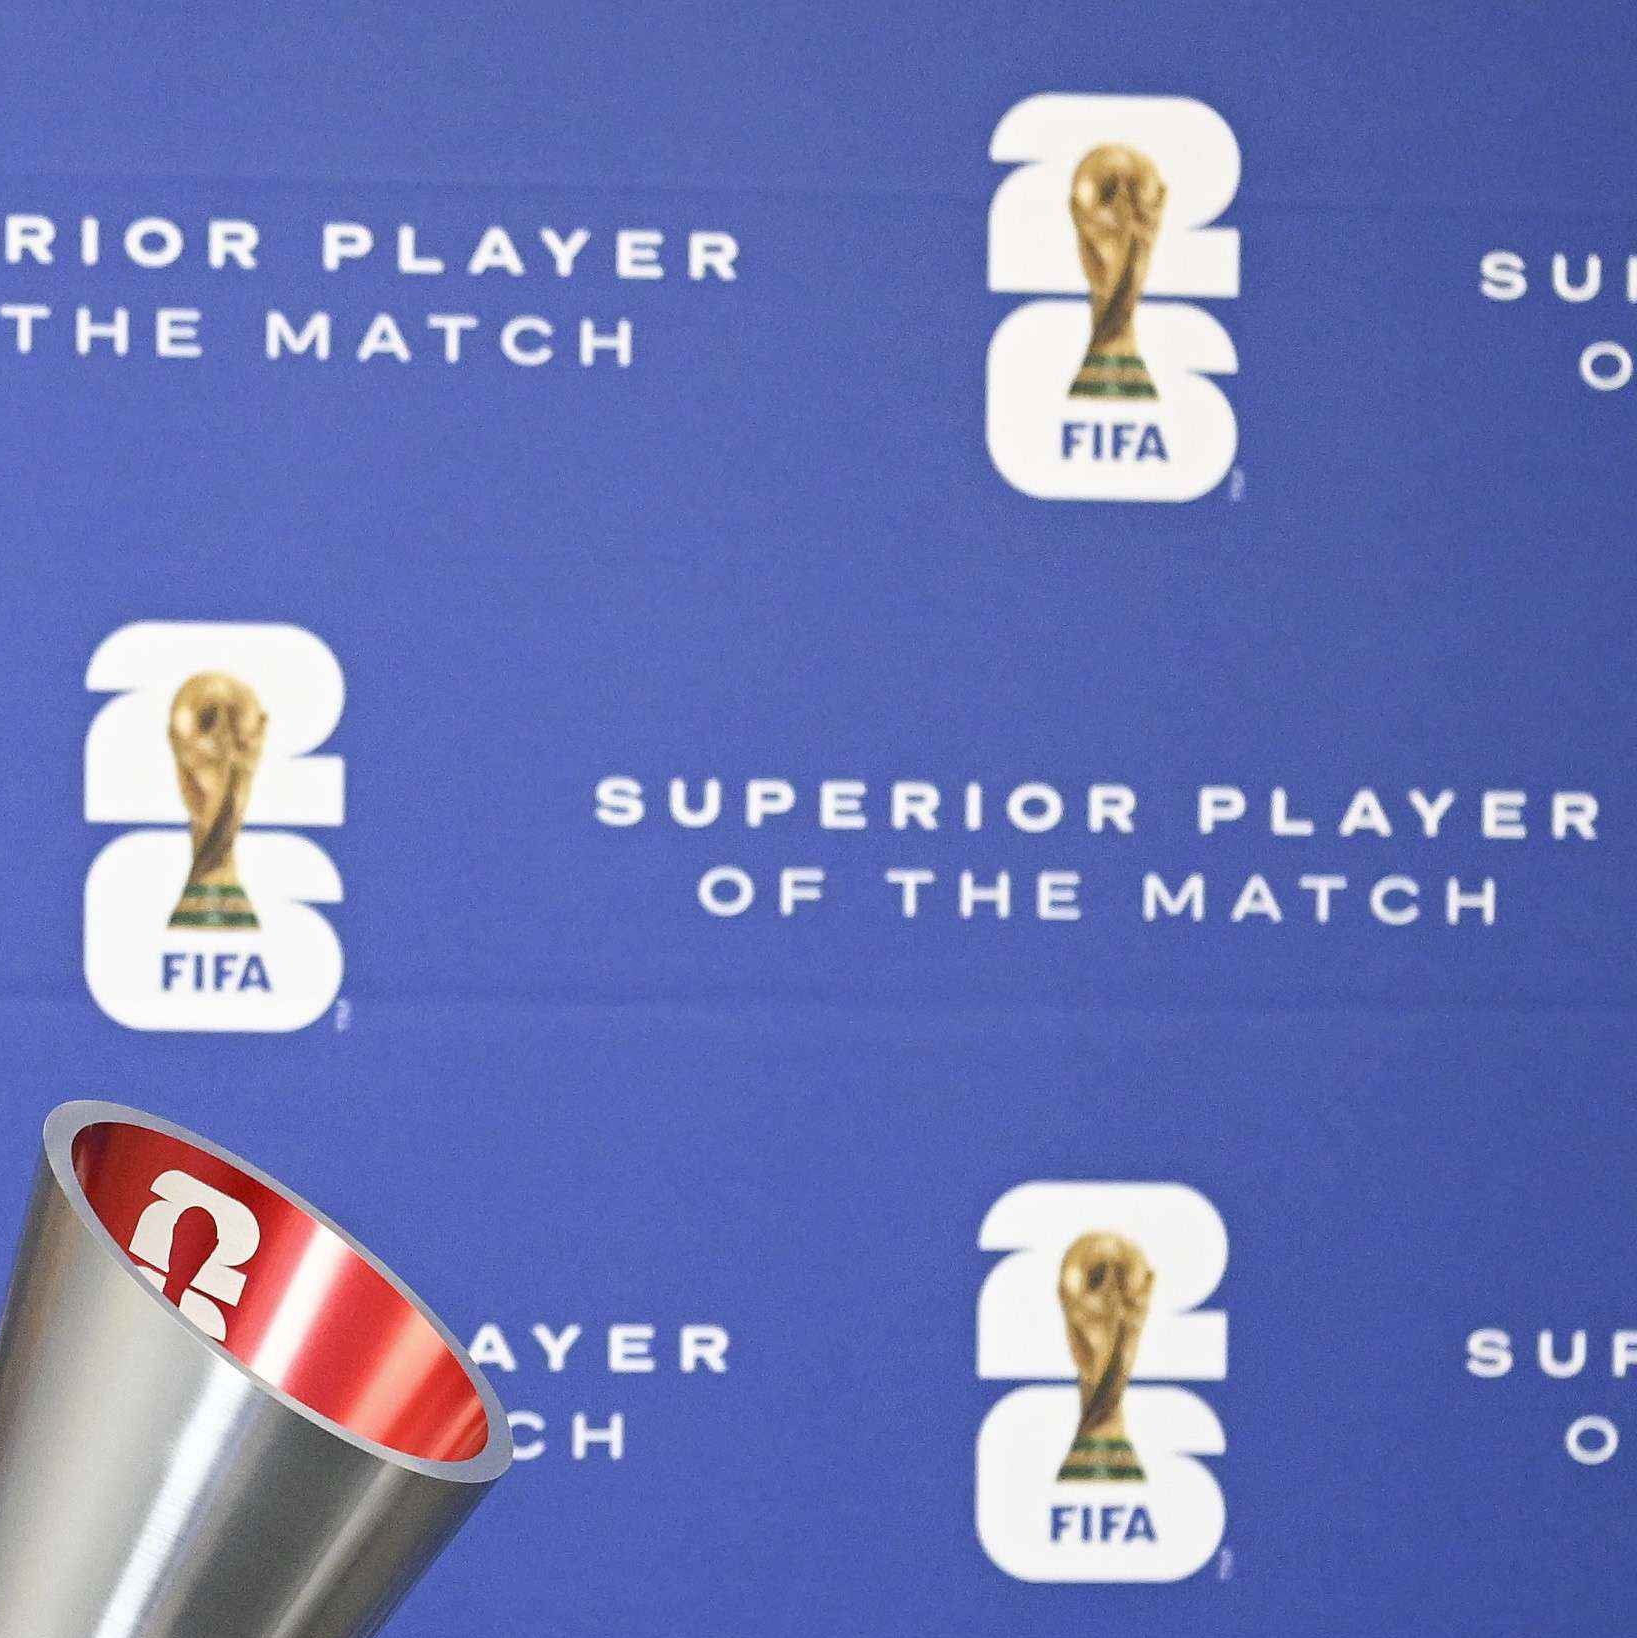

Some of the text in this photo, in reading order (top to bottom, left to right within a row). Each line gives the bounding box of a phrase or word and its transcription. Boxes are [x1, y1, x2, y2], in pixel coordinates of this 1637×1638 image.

[322, 221, 740, 282] PLAYER
[265, 310, 633, 368] MATCH
[1059, 421, 1168, 462] FIFA
[594, 776, 1599, 841] SUPERIOR PLAYER
[697, 865, 1497, 927] OF THE MATCH
[159, 952, 272, 991] FIFA
[468, 1322, 730, 1374] AYER
[1048, 1505, 1157, 1543] FIFA
